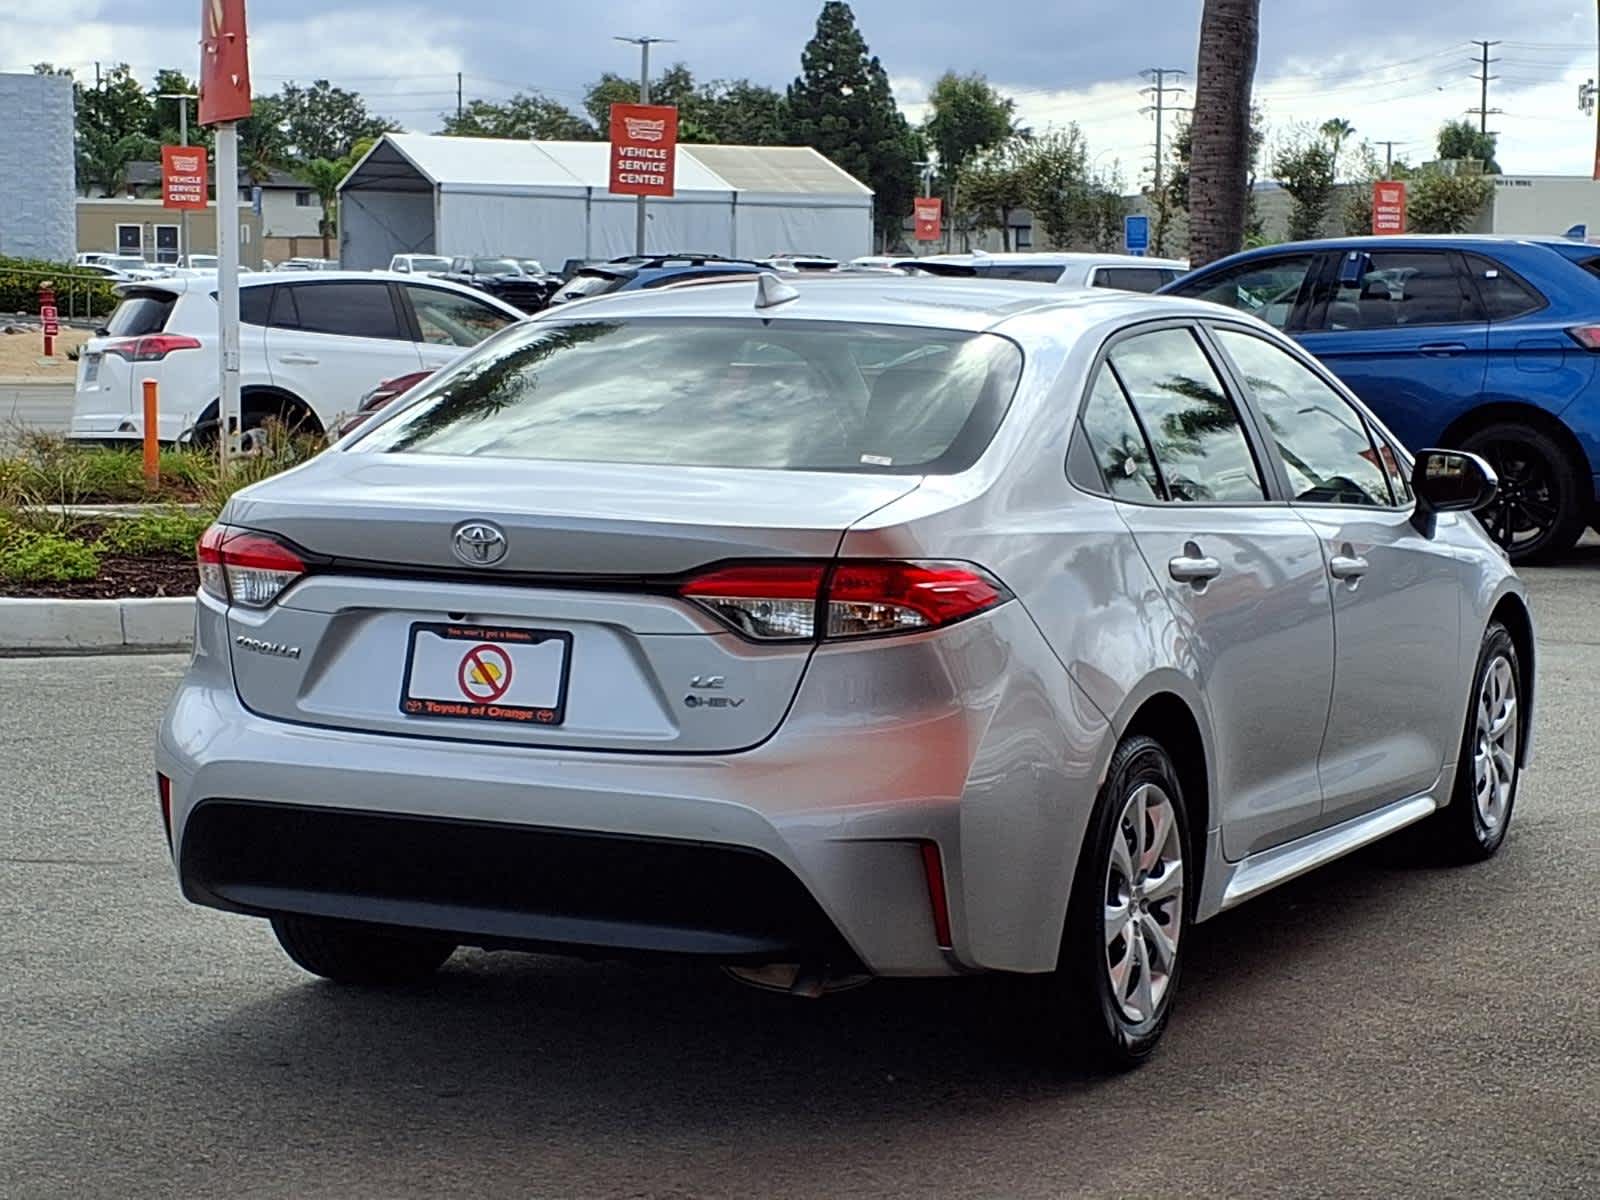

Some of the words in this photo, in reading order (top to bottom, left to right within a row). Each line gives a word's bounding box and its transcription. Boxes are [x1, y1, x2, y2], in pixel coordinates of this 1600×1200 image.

[618, 146, 668, 160] VEHICLE
[618, 159, 667, 172] SERVICE
[168, 176, 201, 184] VEHICLE
[618, 173, 665, 185] CENTER
[168, 184, 201, 193] SERVICE
[169, 193, 201, 202] CENTER
[235, 635, 302, 660] COROLLA
[690, 676, 725, 689] LE
[425, 701, 469, 714] Toyota
[471, 705, 485, 716] of
[487, 706, 534, 720] Orange
